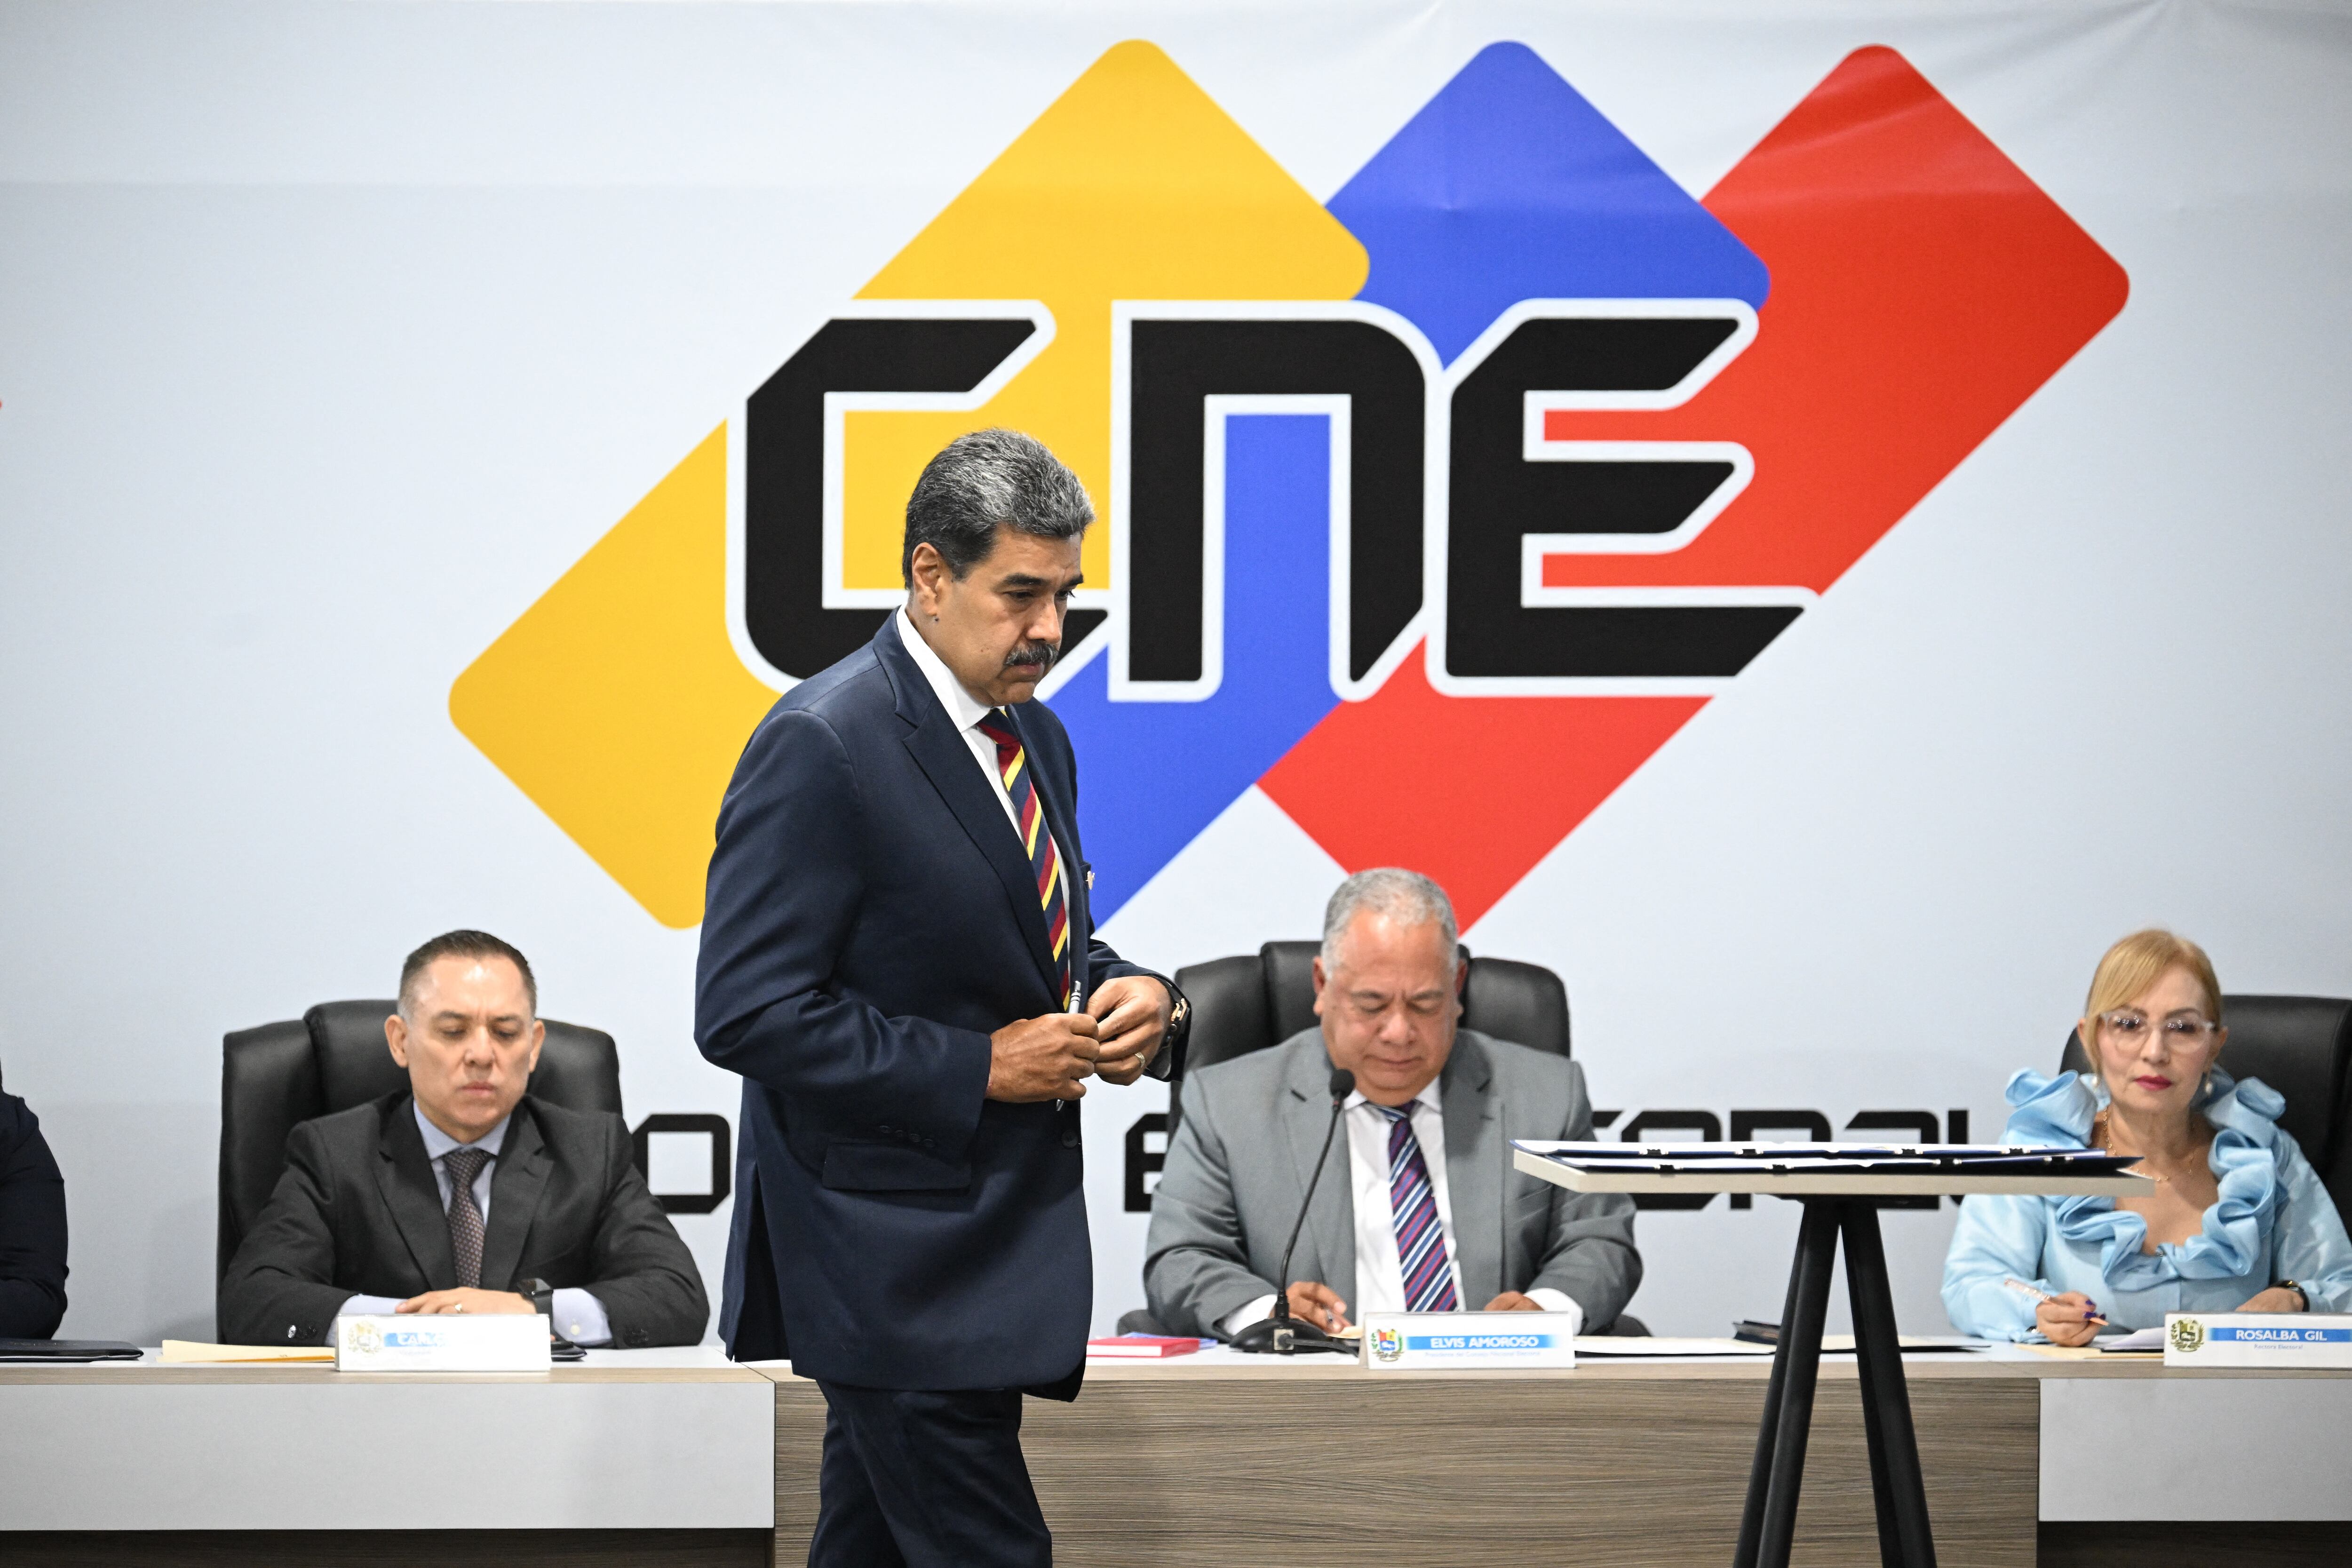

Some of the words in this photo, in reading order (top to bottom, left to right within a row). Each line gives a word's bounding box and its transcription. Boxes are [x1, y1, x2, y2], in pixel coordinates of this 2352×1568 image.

[743, 315, 1807, 685] CNE
[2236, 1329, 2300, 1341] ROSALBA
[2304, 1330, 2328, 1341] GIL
[1430, 1337, 1465, 1348] ELVIS
[1468, 1336, 1539, 1348] AMOROSO
